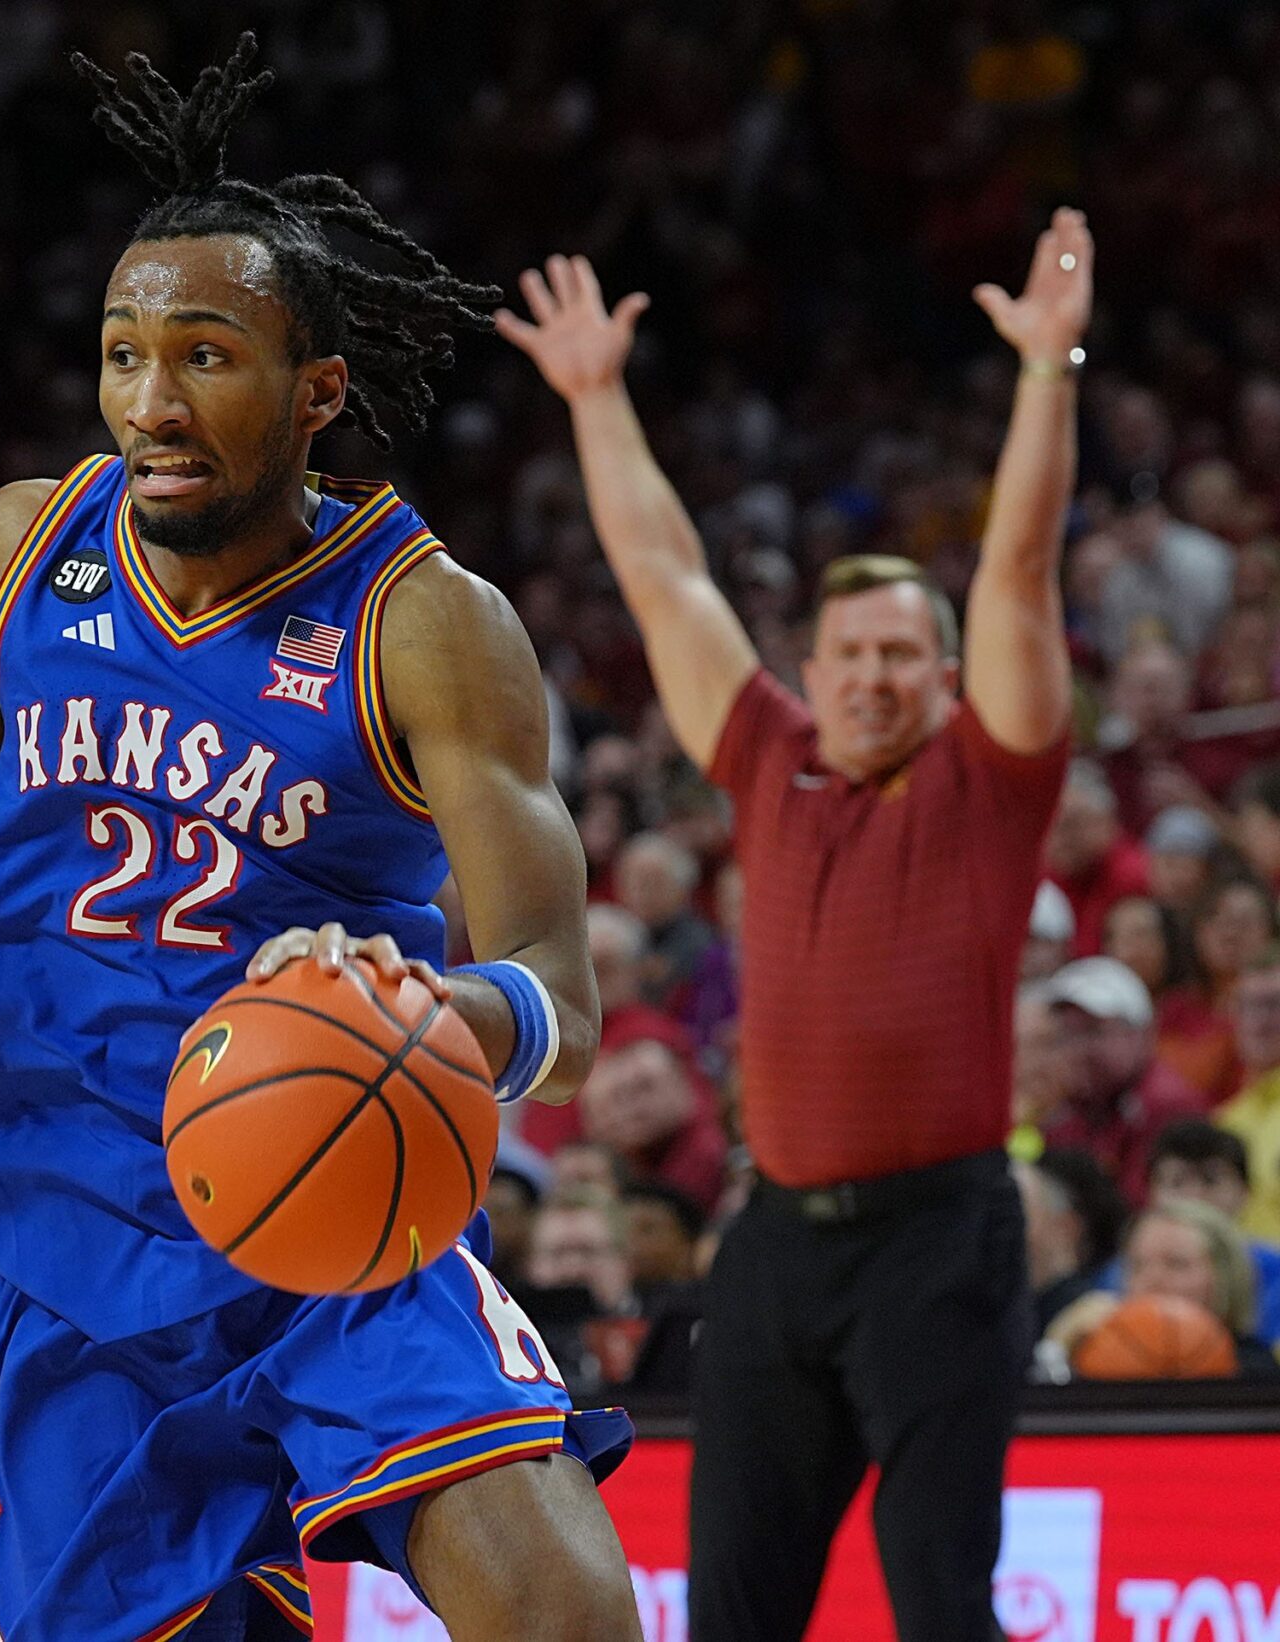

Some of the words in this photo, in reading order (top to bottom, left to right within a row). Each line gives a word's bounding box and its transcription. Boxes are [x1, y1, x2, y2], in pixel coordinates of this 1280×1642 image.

[54, 559, 108, 594] SW
[263, 659, 337, 714] XII
[16, 697, 328, 849] KANSAS
[67, 803, 245, 953] 22
